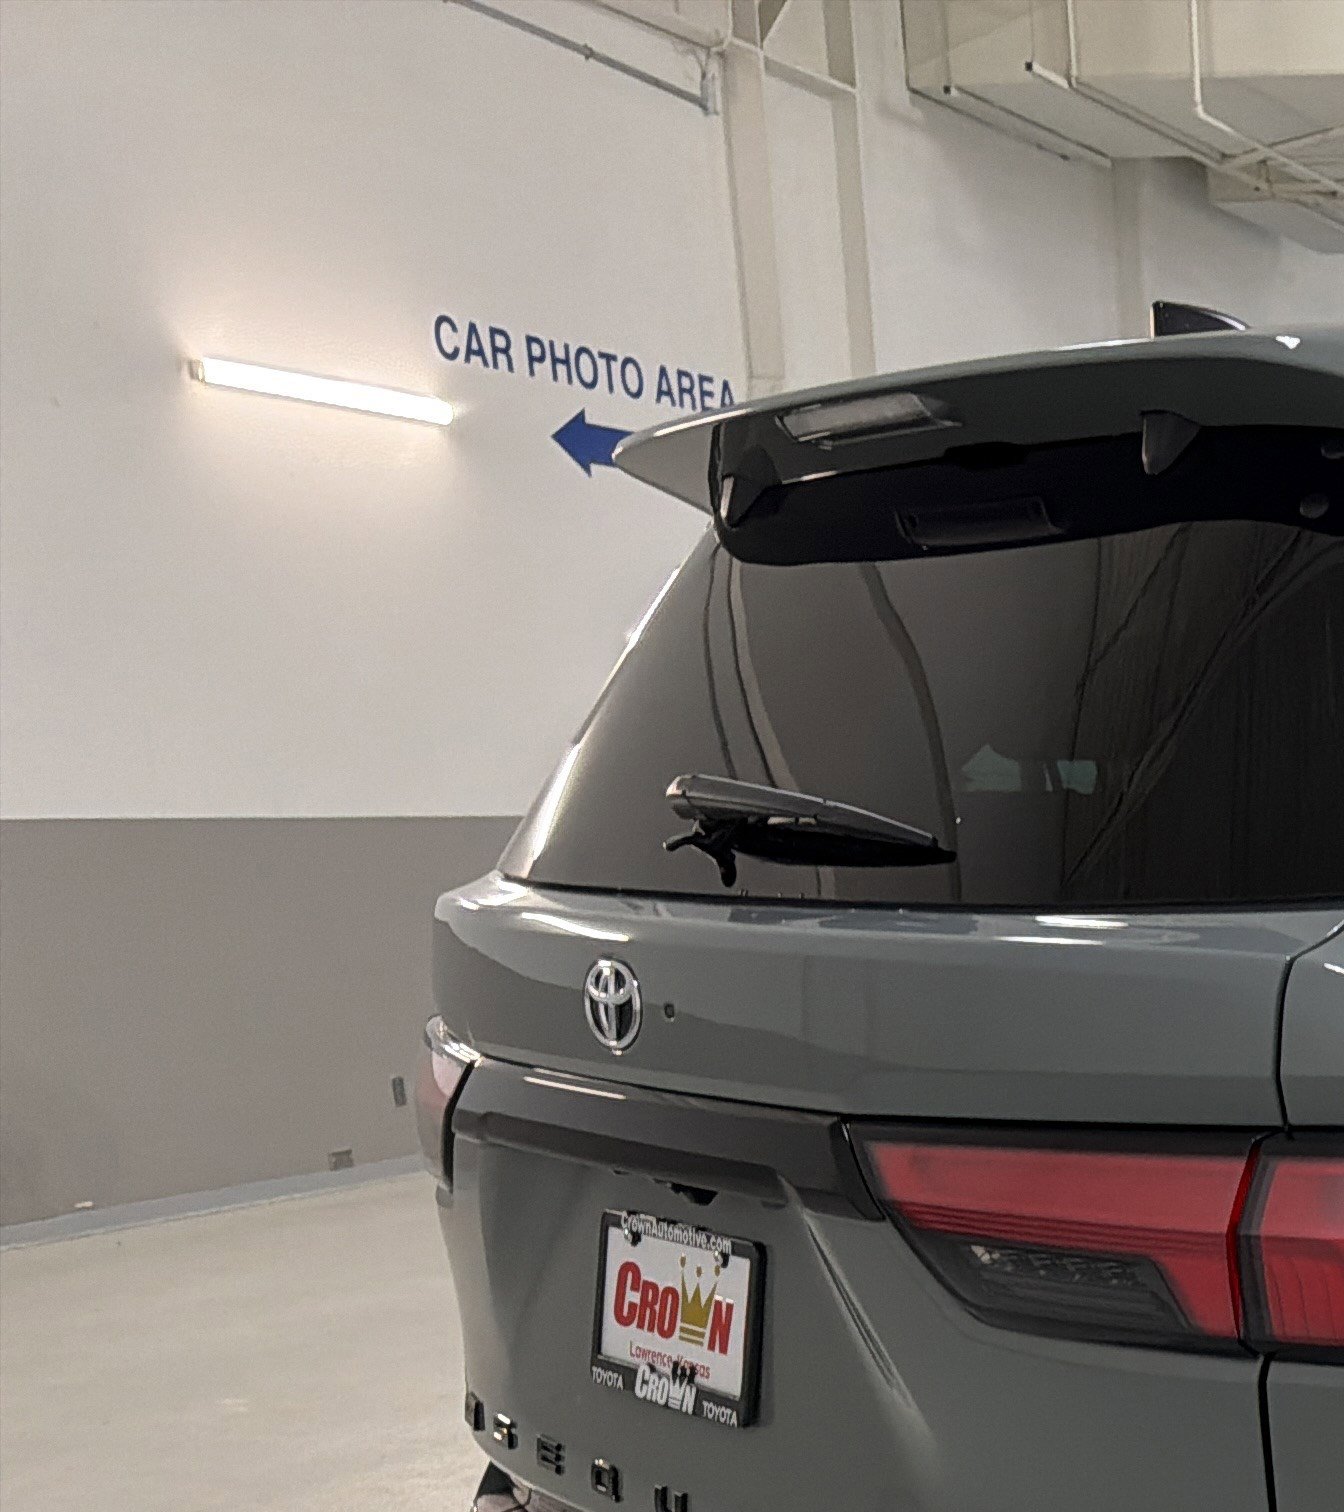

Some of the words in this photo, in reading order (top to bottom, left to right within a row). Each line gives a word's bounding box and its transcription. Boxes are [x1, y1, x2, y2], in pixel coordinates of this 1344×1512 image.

[433, 314, 514, 374] CAR
[525, 334, 645, 401] PHOTO
[655, 363, 736, 413] AREA
[613, 1252, 734, 1355] CROWN
[592, 1366, 624, 1391] TOYOTA
[635, 1362, 697, 1415] CROWN
[702, 1400, 738, 1428] TOYOTA
